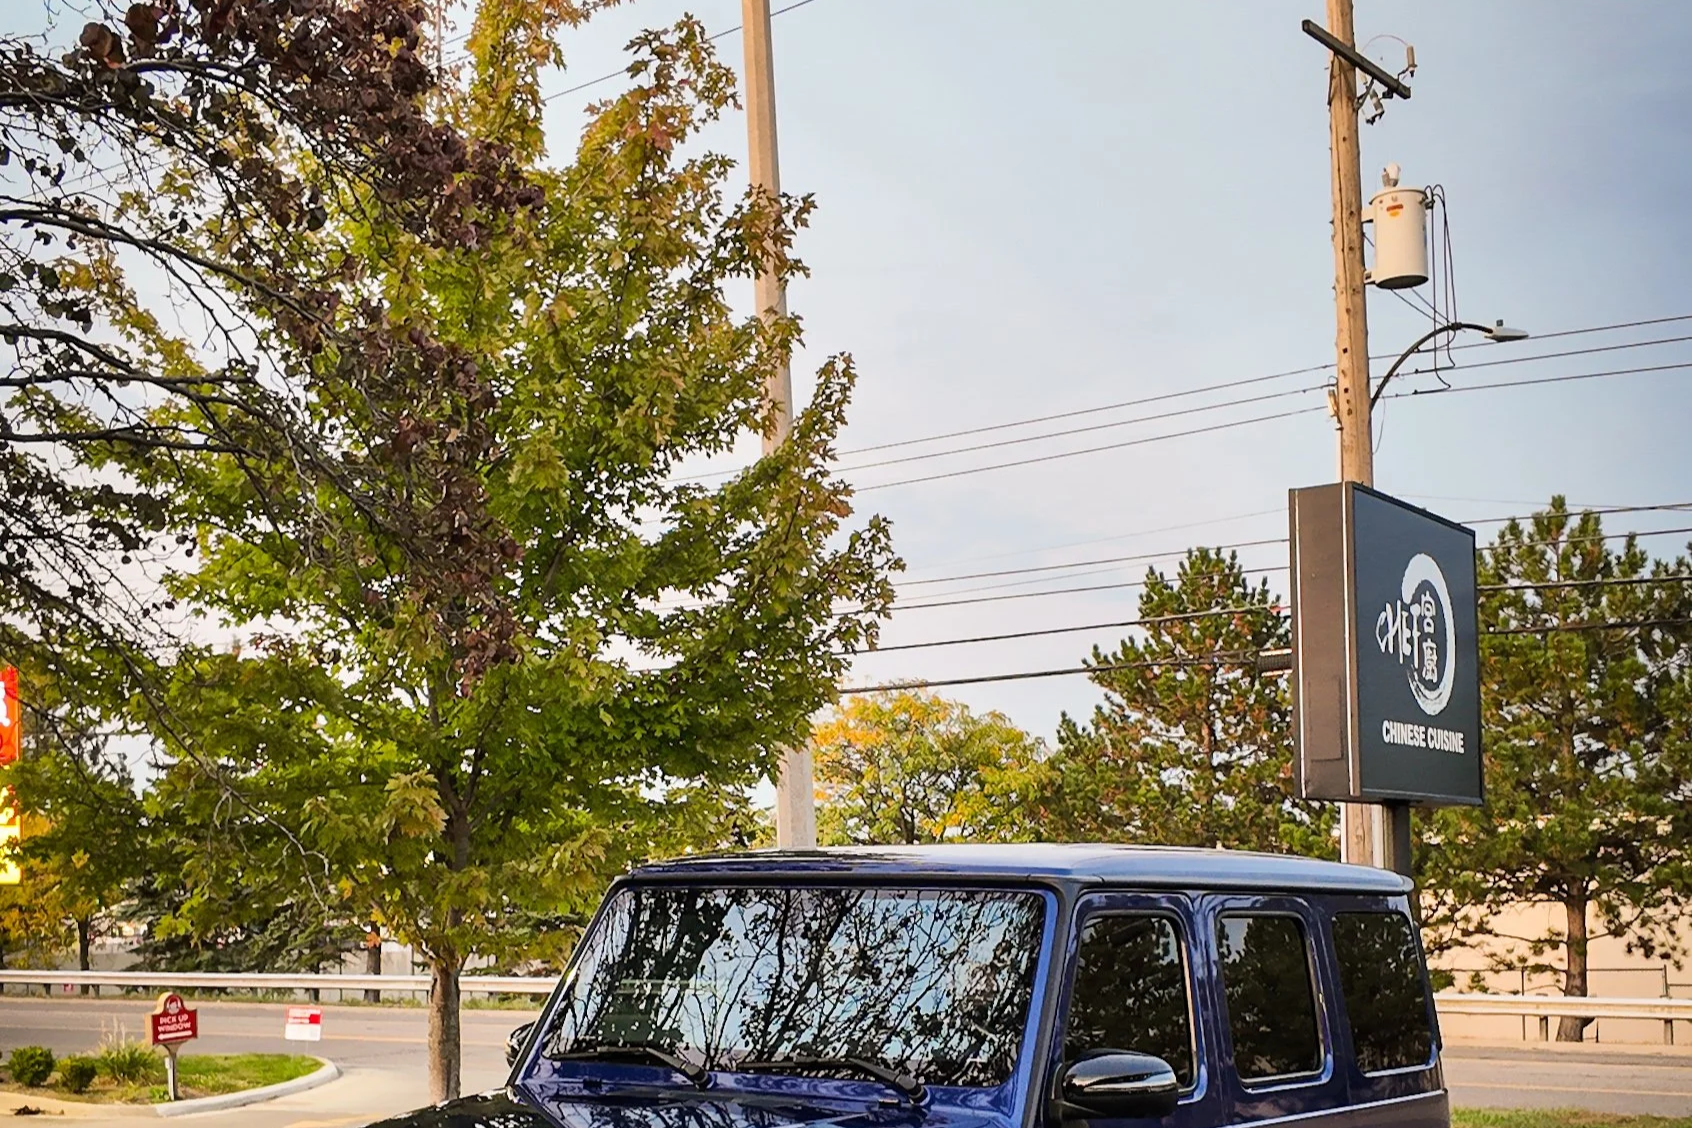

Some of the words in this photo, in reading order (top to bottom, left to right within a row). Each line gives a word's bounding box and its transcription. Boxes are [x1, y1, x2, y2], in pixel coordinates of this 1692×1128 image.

[1382, 720, 1426, 748] CHINESE
[1427, 727, 1465, 754] CUISINE
[159, 1015, 177, 1024] PICK
[178, 1013, 189, 1022] UP
[157, 1021, 191, 1032] WINDOW
